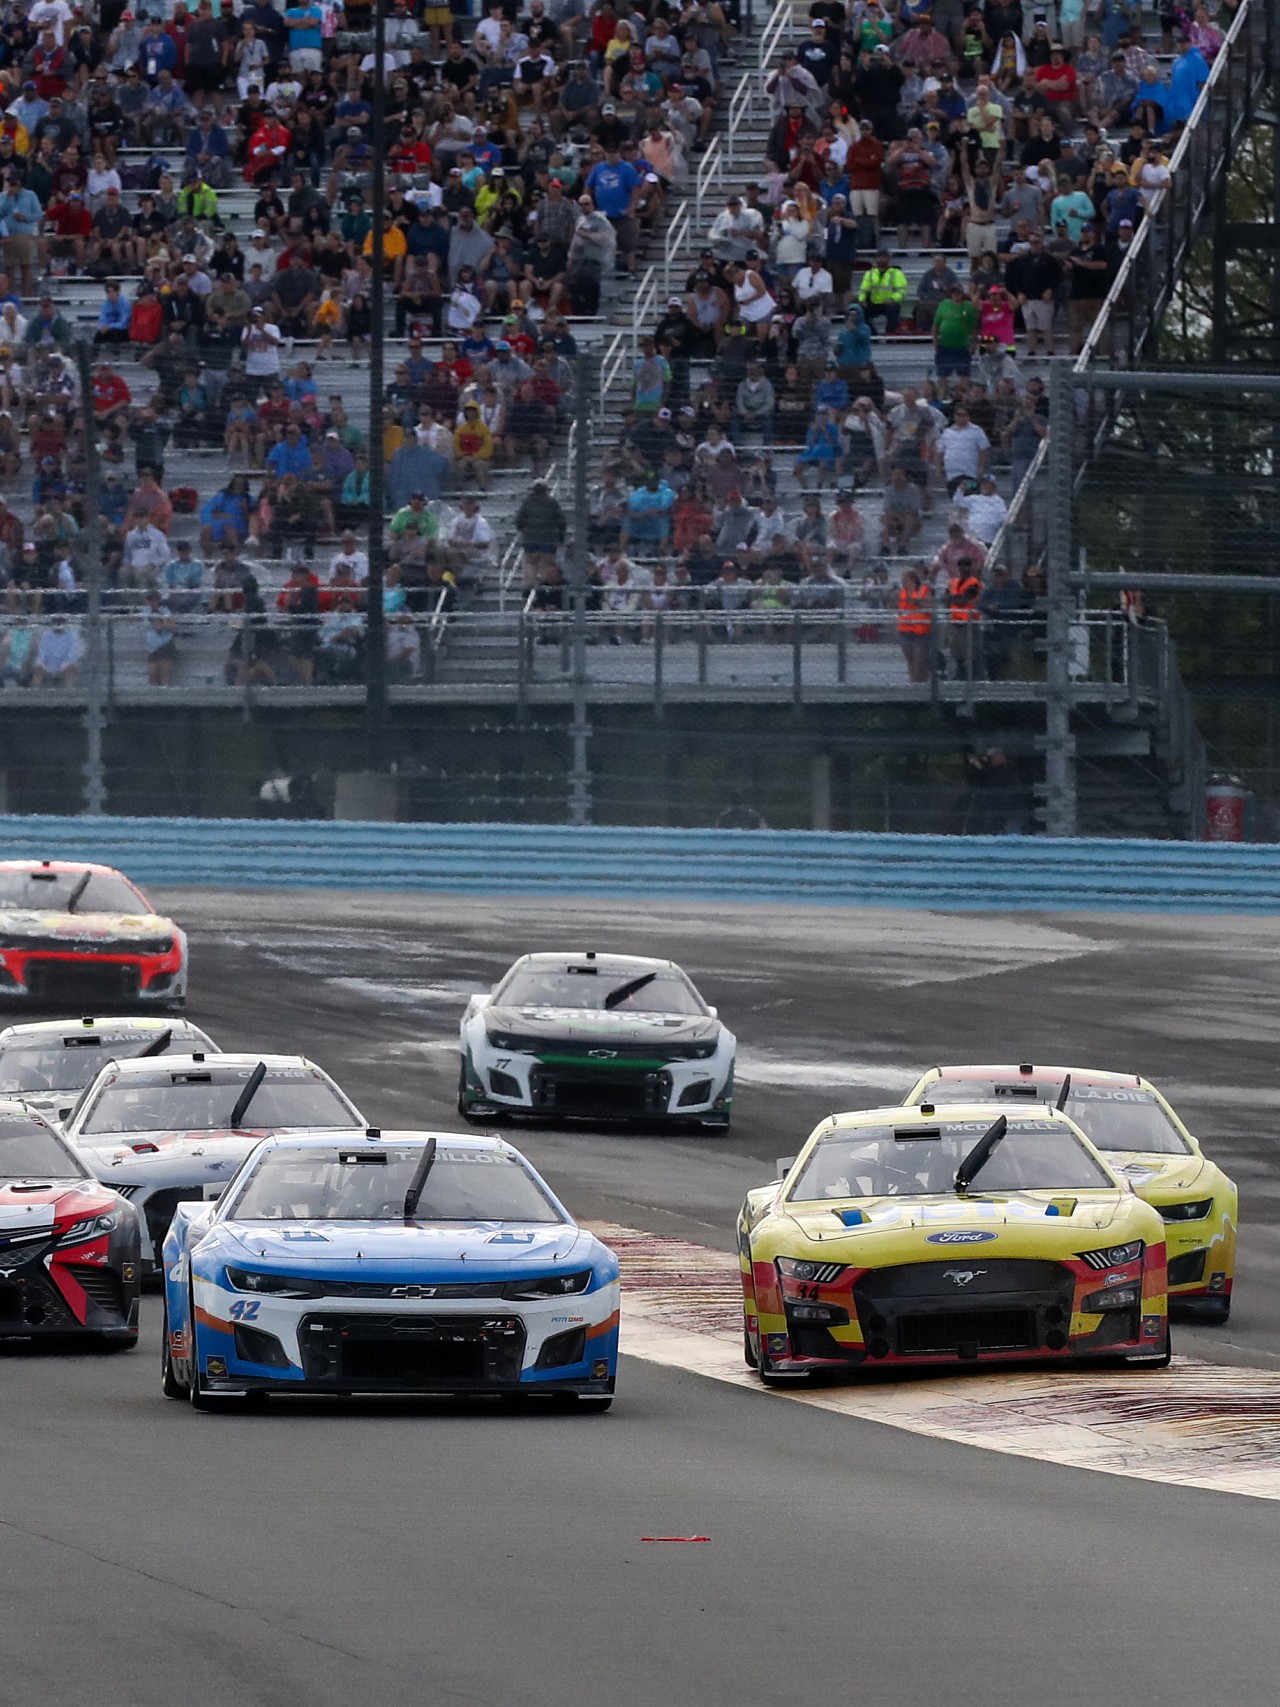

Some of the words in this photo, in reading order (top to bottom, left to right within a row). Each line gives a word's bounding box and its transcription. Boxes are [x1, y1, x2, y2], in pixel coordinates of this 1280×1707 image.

[494, 1058, 512, 1070] 77
[946, 1122, 1059, 1132] MCDWELL
[228, 1299, 262, 1322] 42
